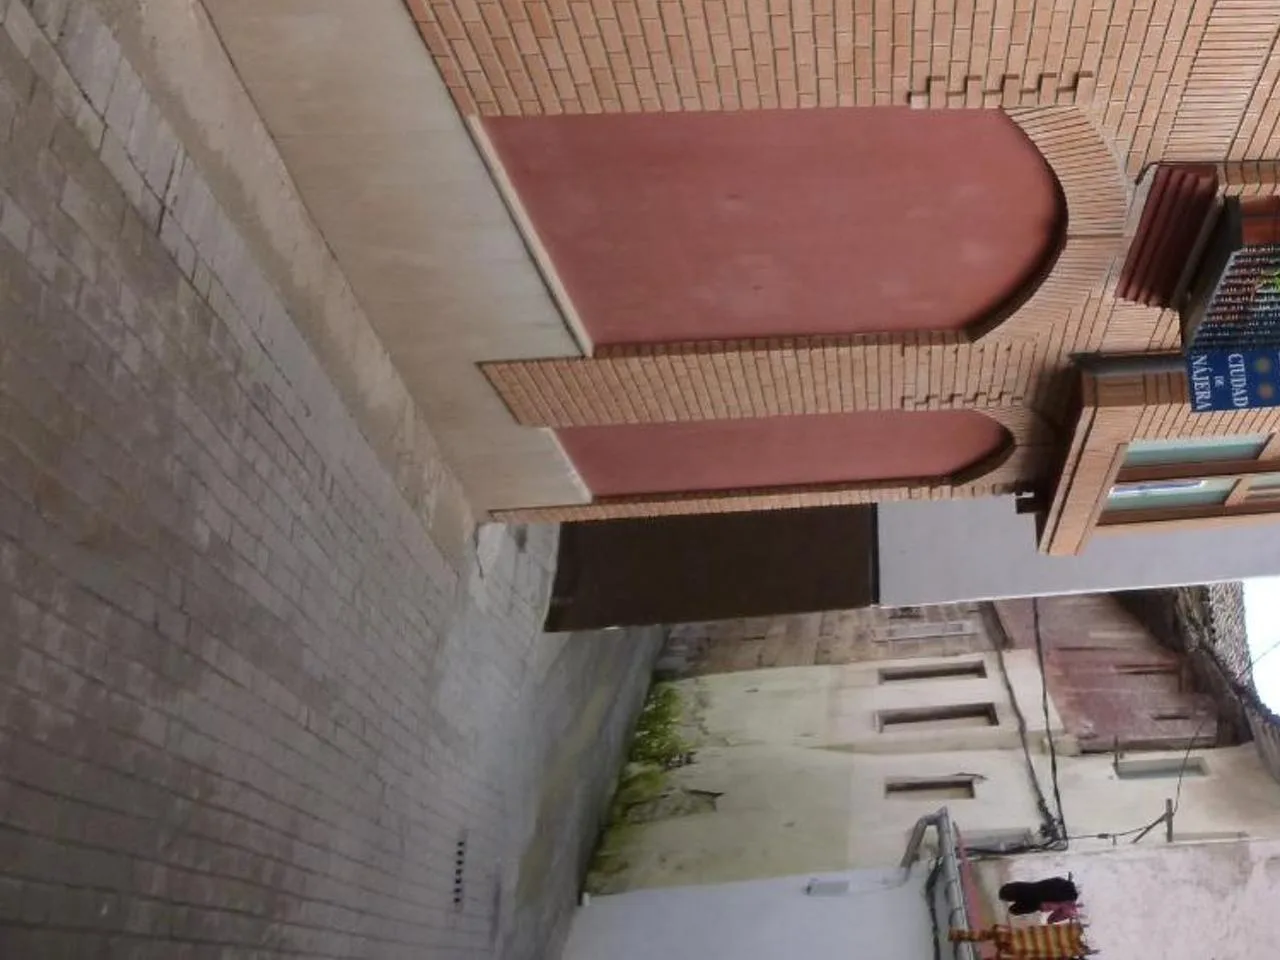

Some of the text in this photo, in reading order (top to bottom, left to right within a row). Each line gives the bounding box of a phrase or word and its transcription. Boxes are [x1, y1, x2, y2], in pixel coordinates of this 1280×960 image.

[1190, 354, 1213, 411] NÁJERA
[1213, 375, 1225, 388] DE
[1228, 353, 1250, 407] CIUDAD
